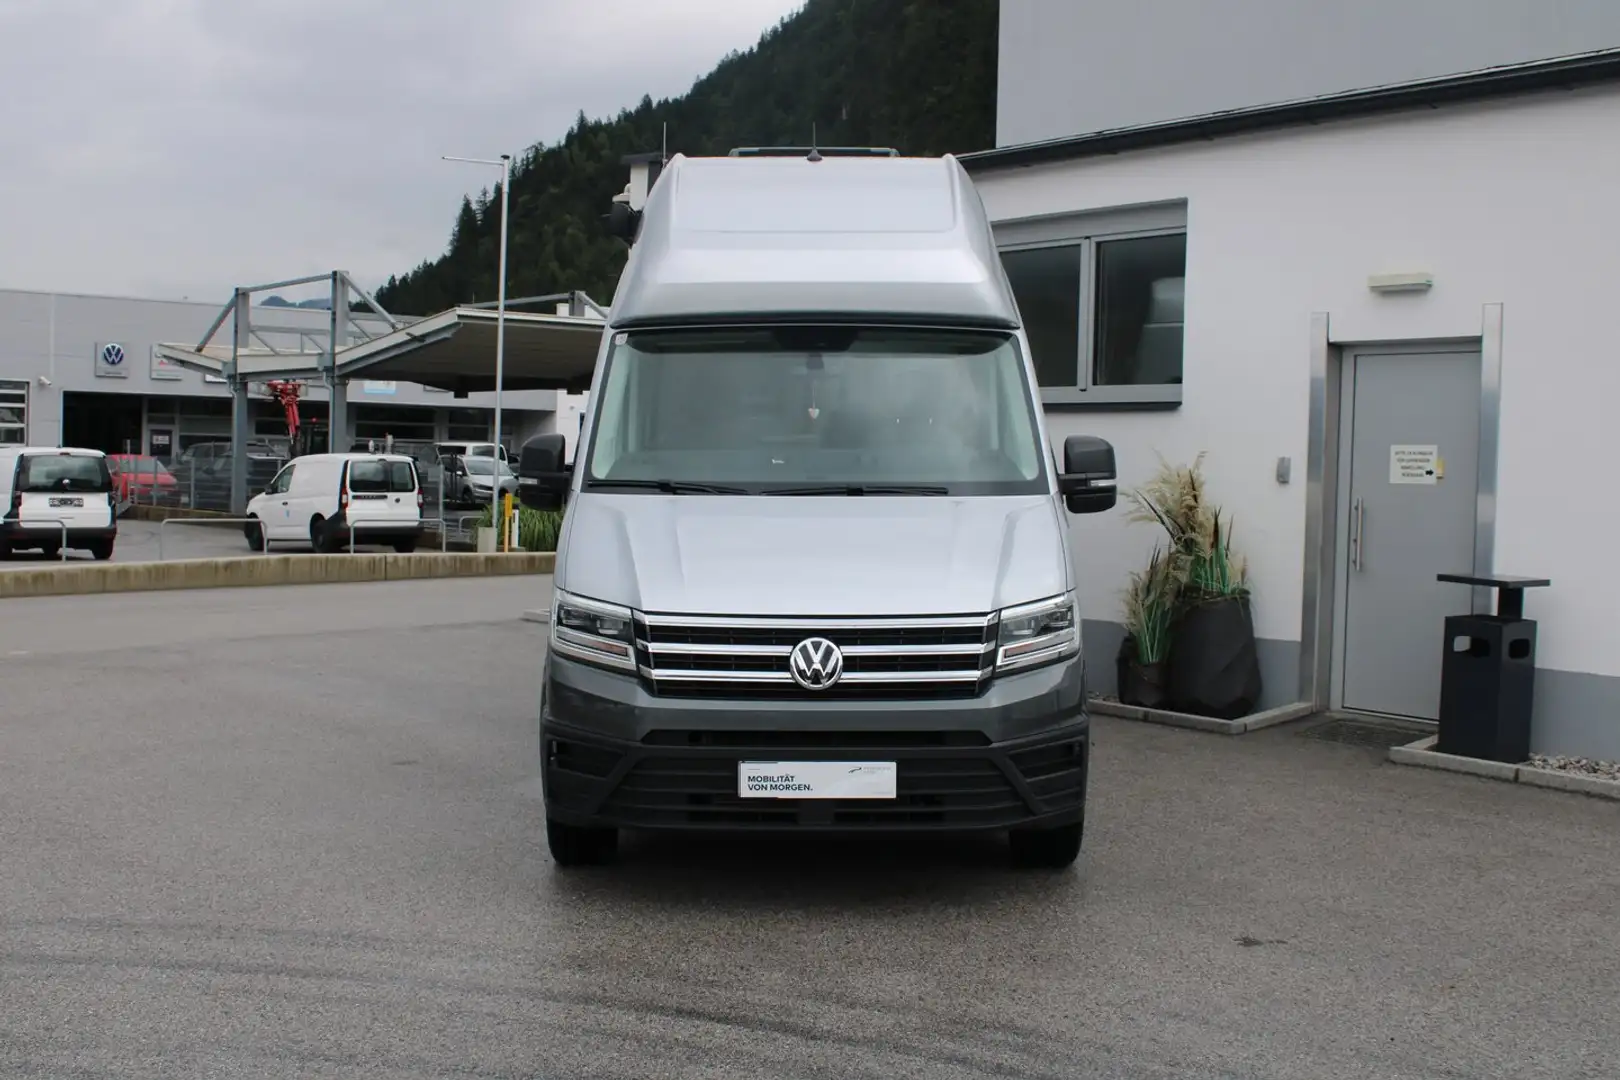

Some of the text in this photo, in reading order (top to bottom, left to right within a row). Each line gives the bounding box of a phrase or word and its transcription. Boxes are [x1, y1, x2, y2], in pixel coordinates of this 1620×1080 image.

[103, 343, 124, 365] VW
[790, 637, 843, 690] VW
[747, 774, 795, 783] MOBILITÄT
[747, 783, 814, 791] VON MORGEN.
